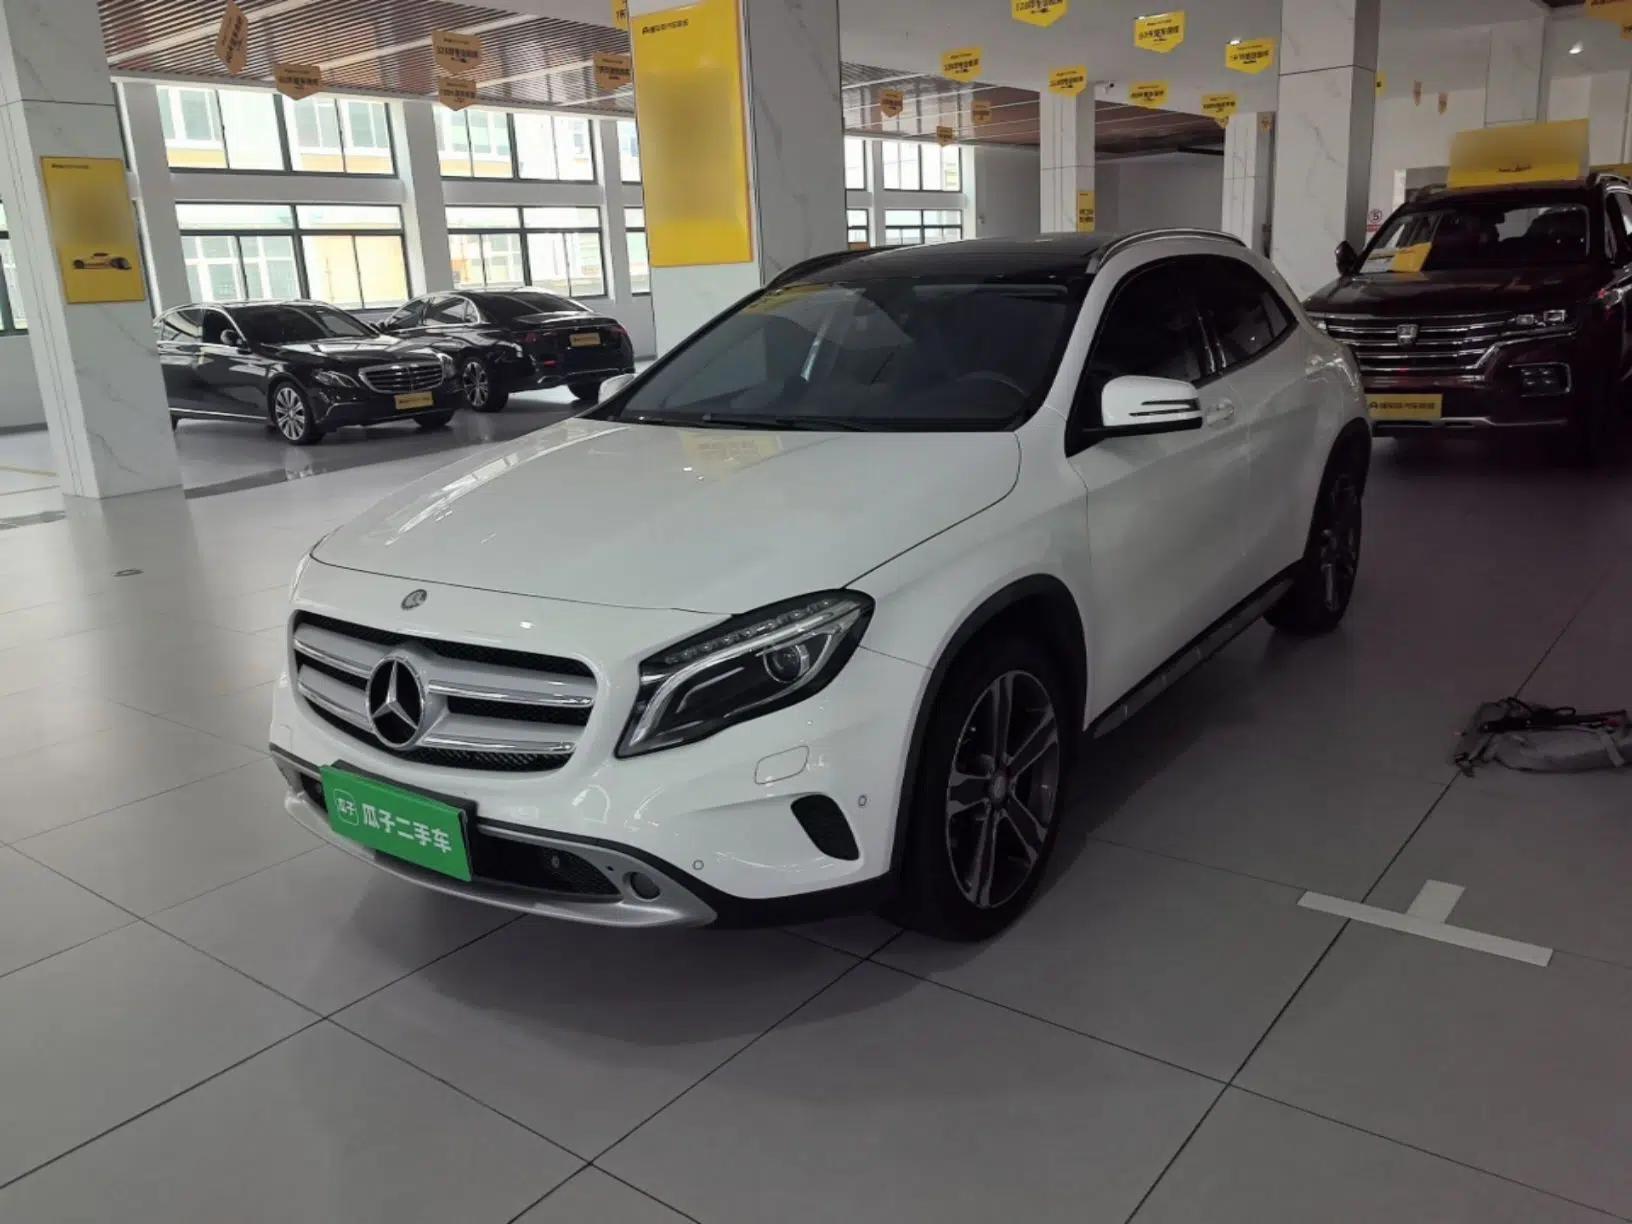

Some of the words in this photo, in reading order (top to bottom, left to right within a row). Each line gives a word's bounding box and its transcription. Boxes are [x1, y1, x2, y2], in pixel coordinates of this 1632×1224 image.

[361, 802, 452, 854] 瓜子二手车
